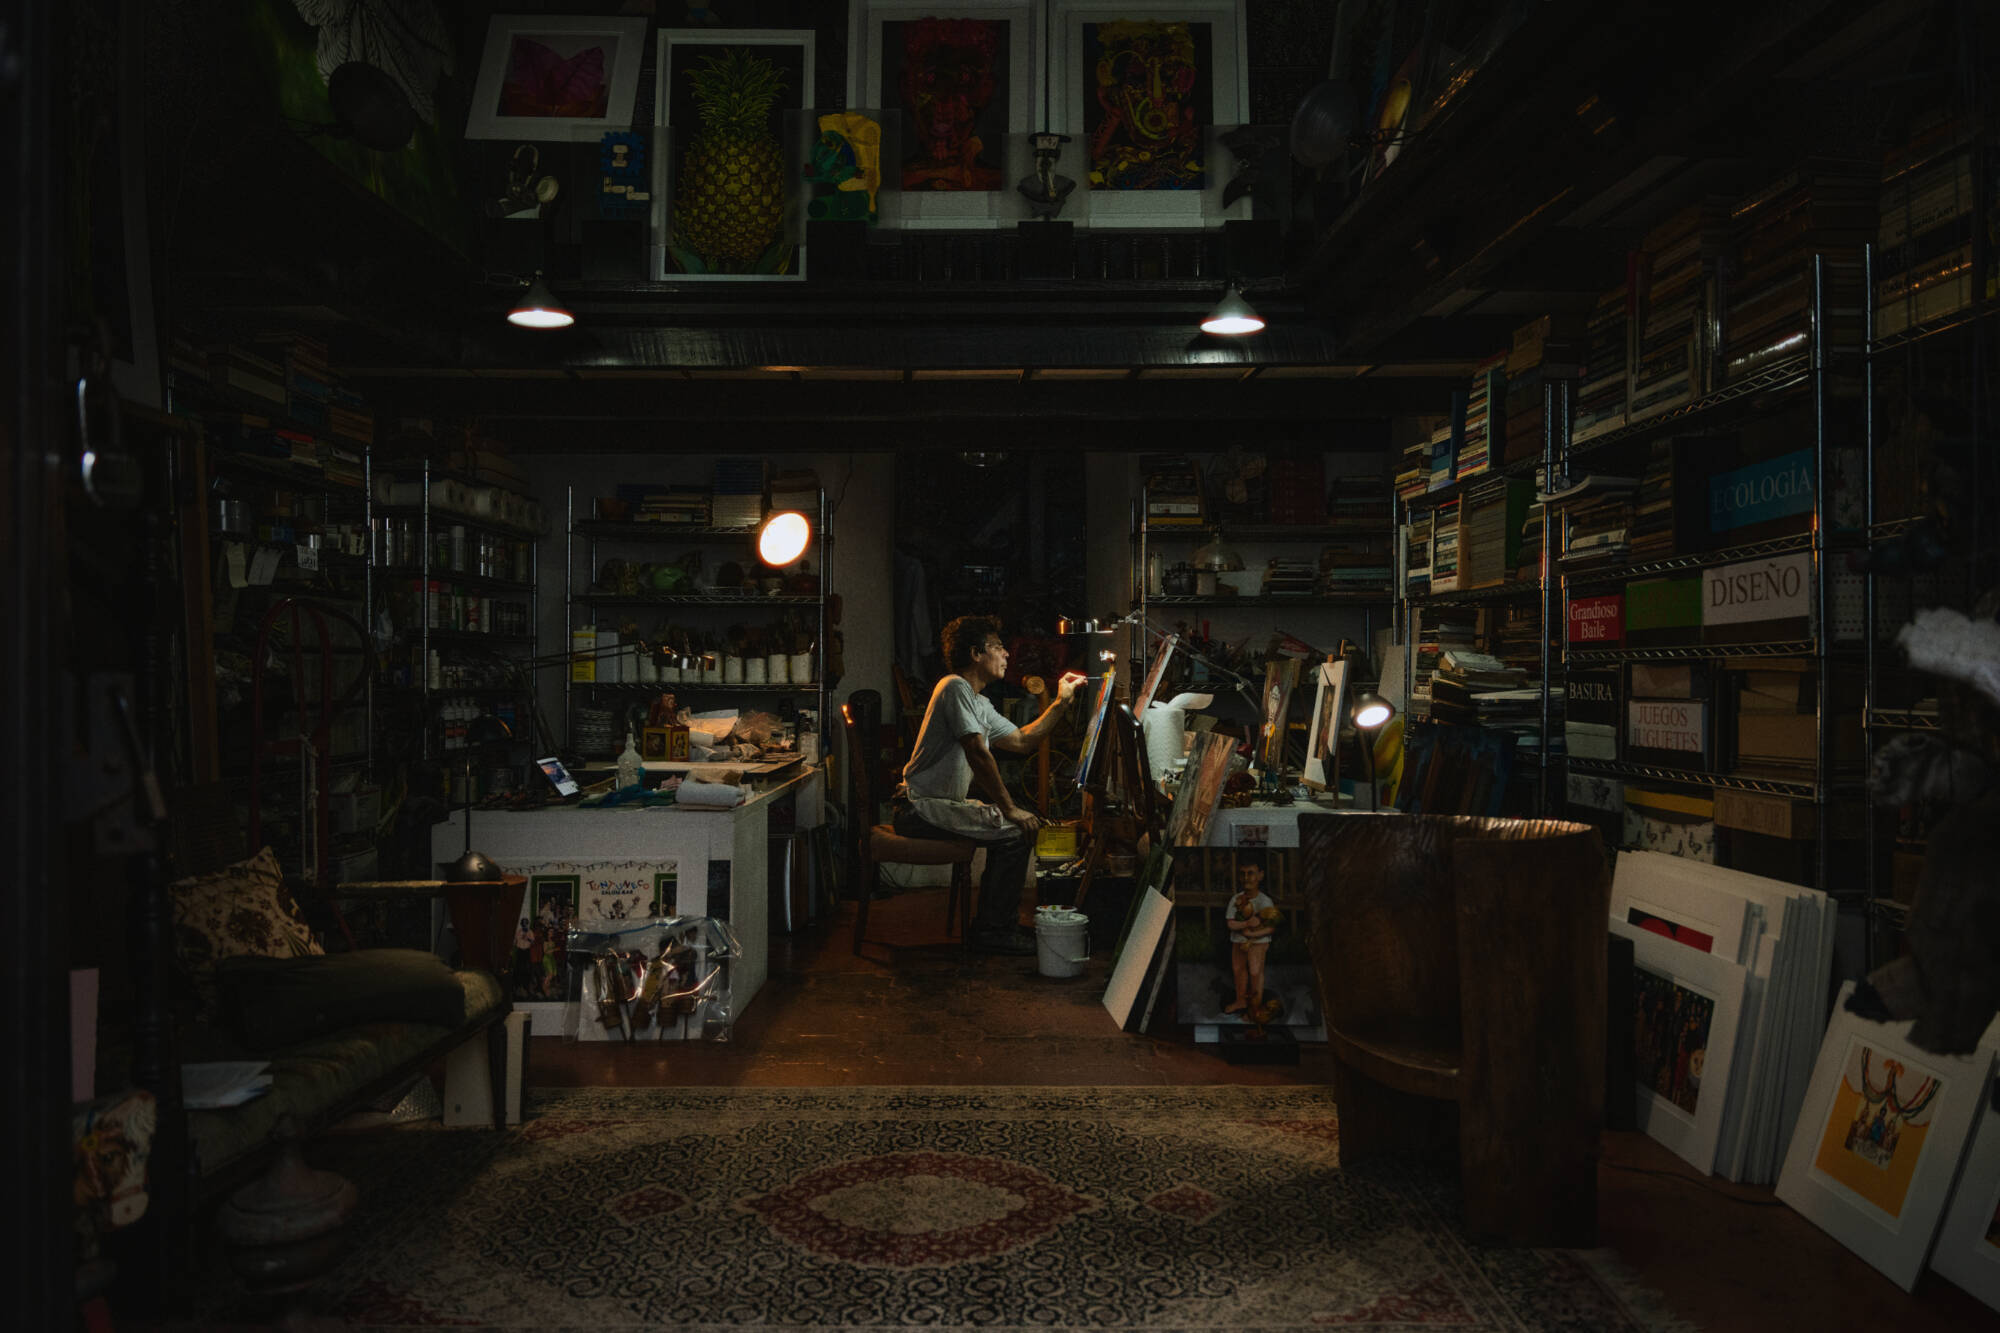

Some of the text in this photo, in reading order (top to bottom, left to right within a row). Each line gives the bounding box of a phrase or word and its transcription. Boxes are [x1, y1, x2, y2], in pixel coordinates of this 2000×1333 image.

[1712, 461, 1811, 514] ECOLOGÍA
[1711, 563, 1801, 607] DISEÑO
[1570, 602, 1617, 620] Grandioso
[1581, 621, 1606, 639] Baile
[1569, 682, 1613, 701] BASURA
[1638, 704, 1688, 726] JUEGOS
[1633, 728, 1698, 751] JUGUETES
